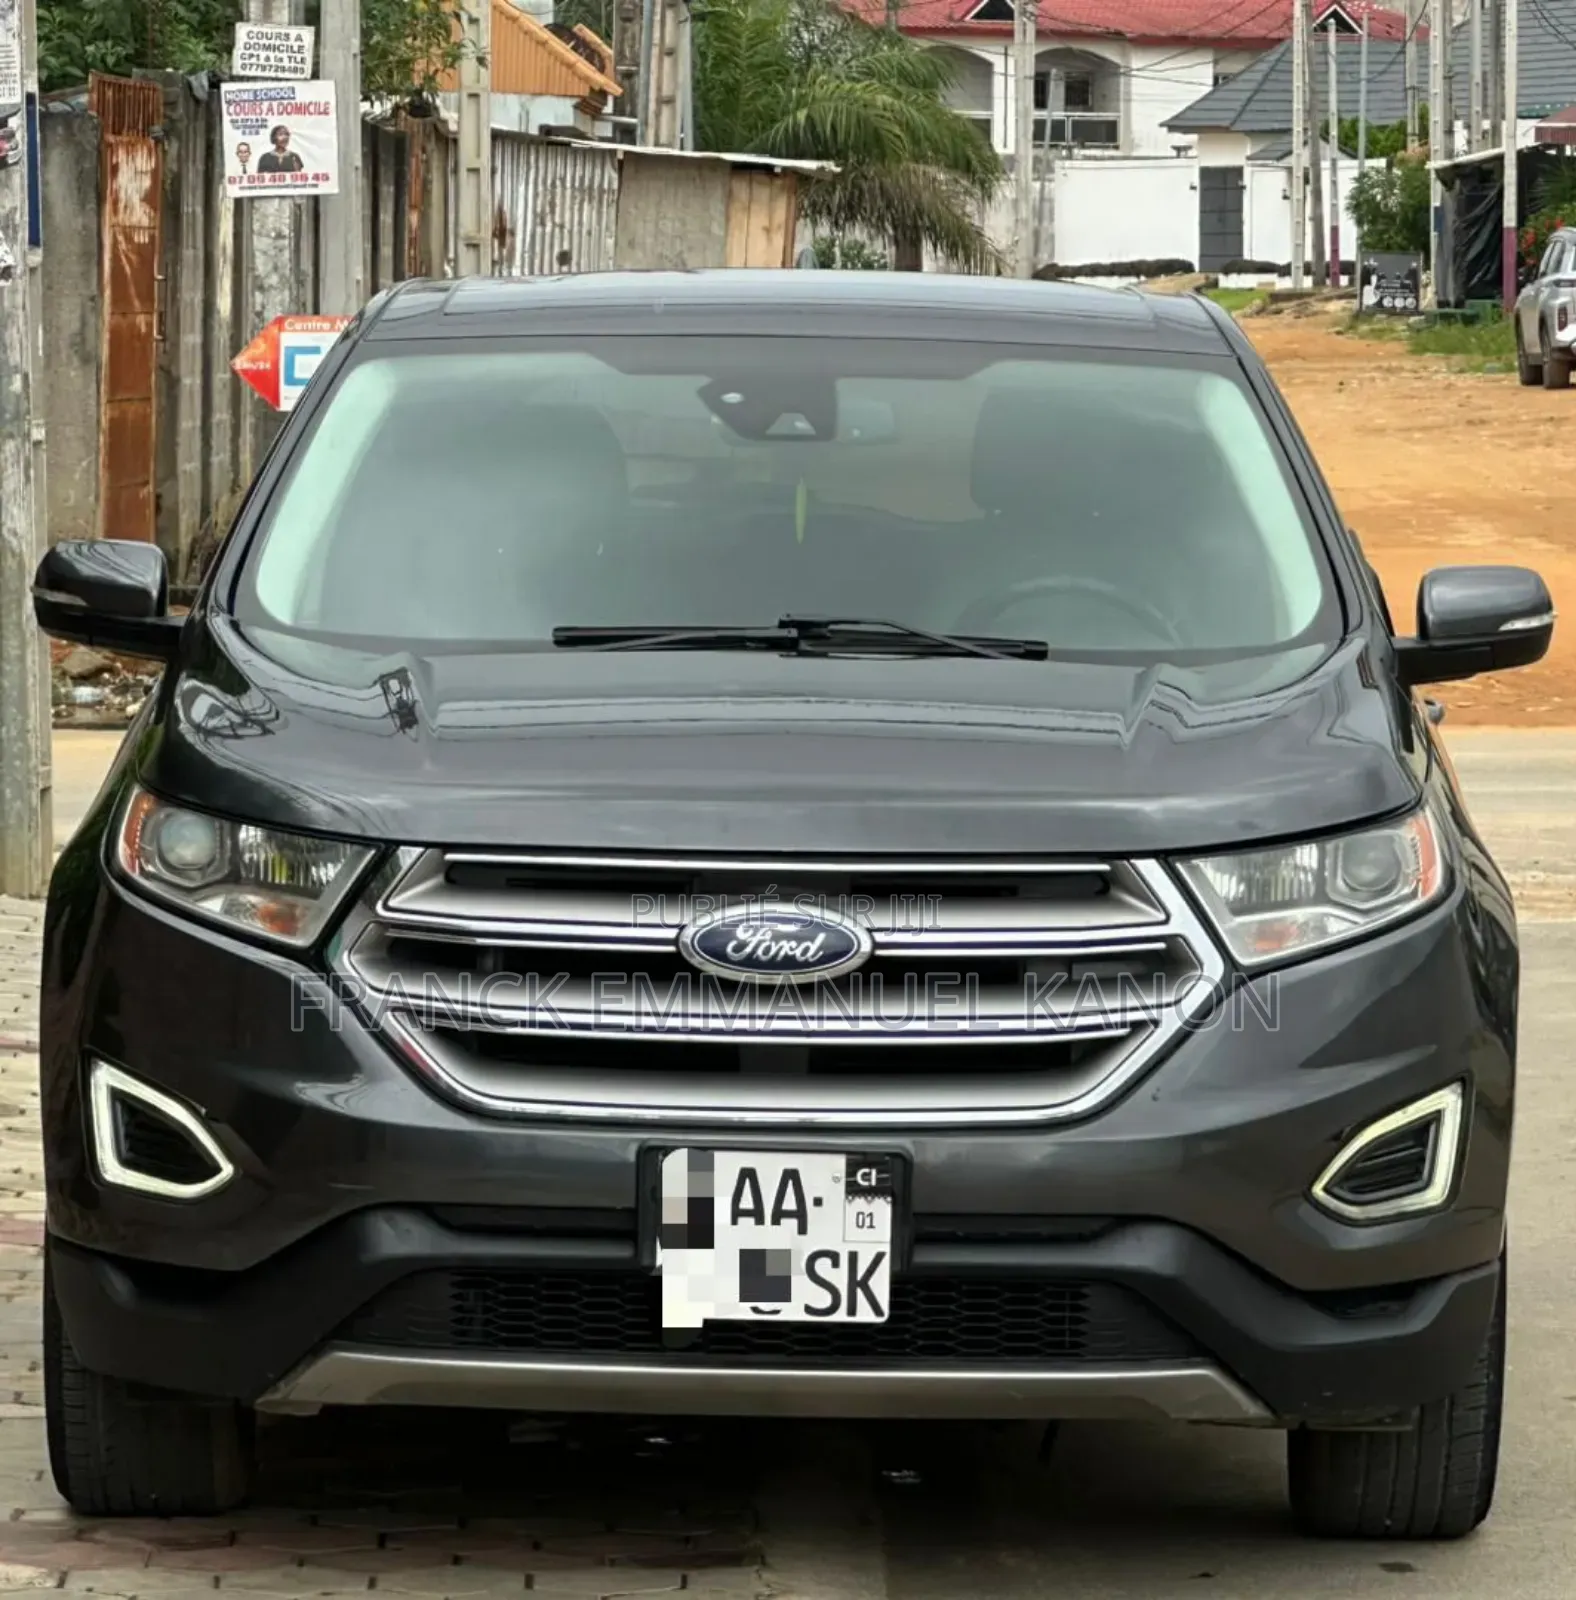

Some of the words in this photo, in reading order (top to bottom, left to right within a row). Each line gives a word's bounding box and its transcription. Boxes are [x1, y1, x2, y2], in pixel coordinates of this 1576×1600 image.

[247, 30, 291, 42] COURS
[294, 33, 303, 42] A
[243, 42, 305, 54] DOMICILE
[240, 52, 261, 62] CP1
[287, 55, 307, 65] TLE
[225, 90, 254, 100] HOME
[255, 88, 295, 99] SCHOOL
[226, 101, 262, 116] COURS
[265, 102, 274, 116] A
[277, 101, 330, 116] DOMICILE
[284, 319, 331, 330] Centre
[726, 923, 827, 963] Ford
[856, 1168, 877, 1186] CI
[855, 1212, 876, 1229] 01
[804, 1249, 887, 1318] SK
